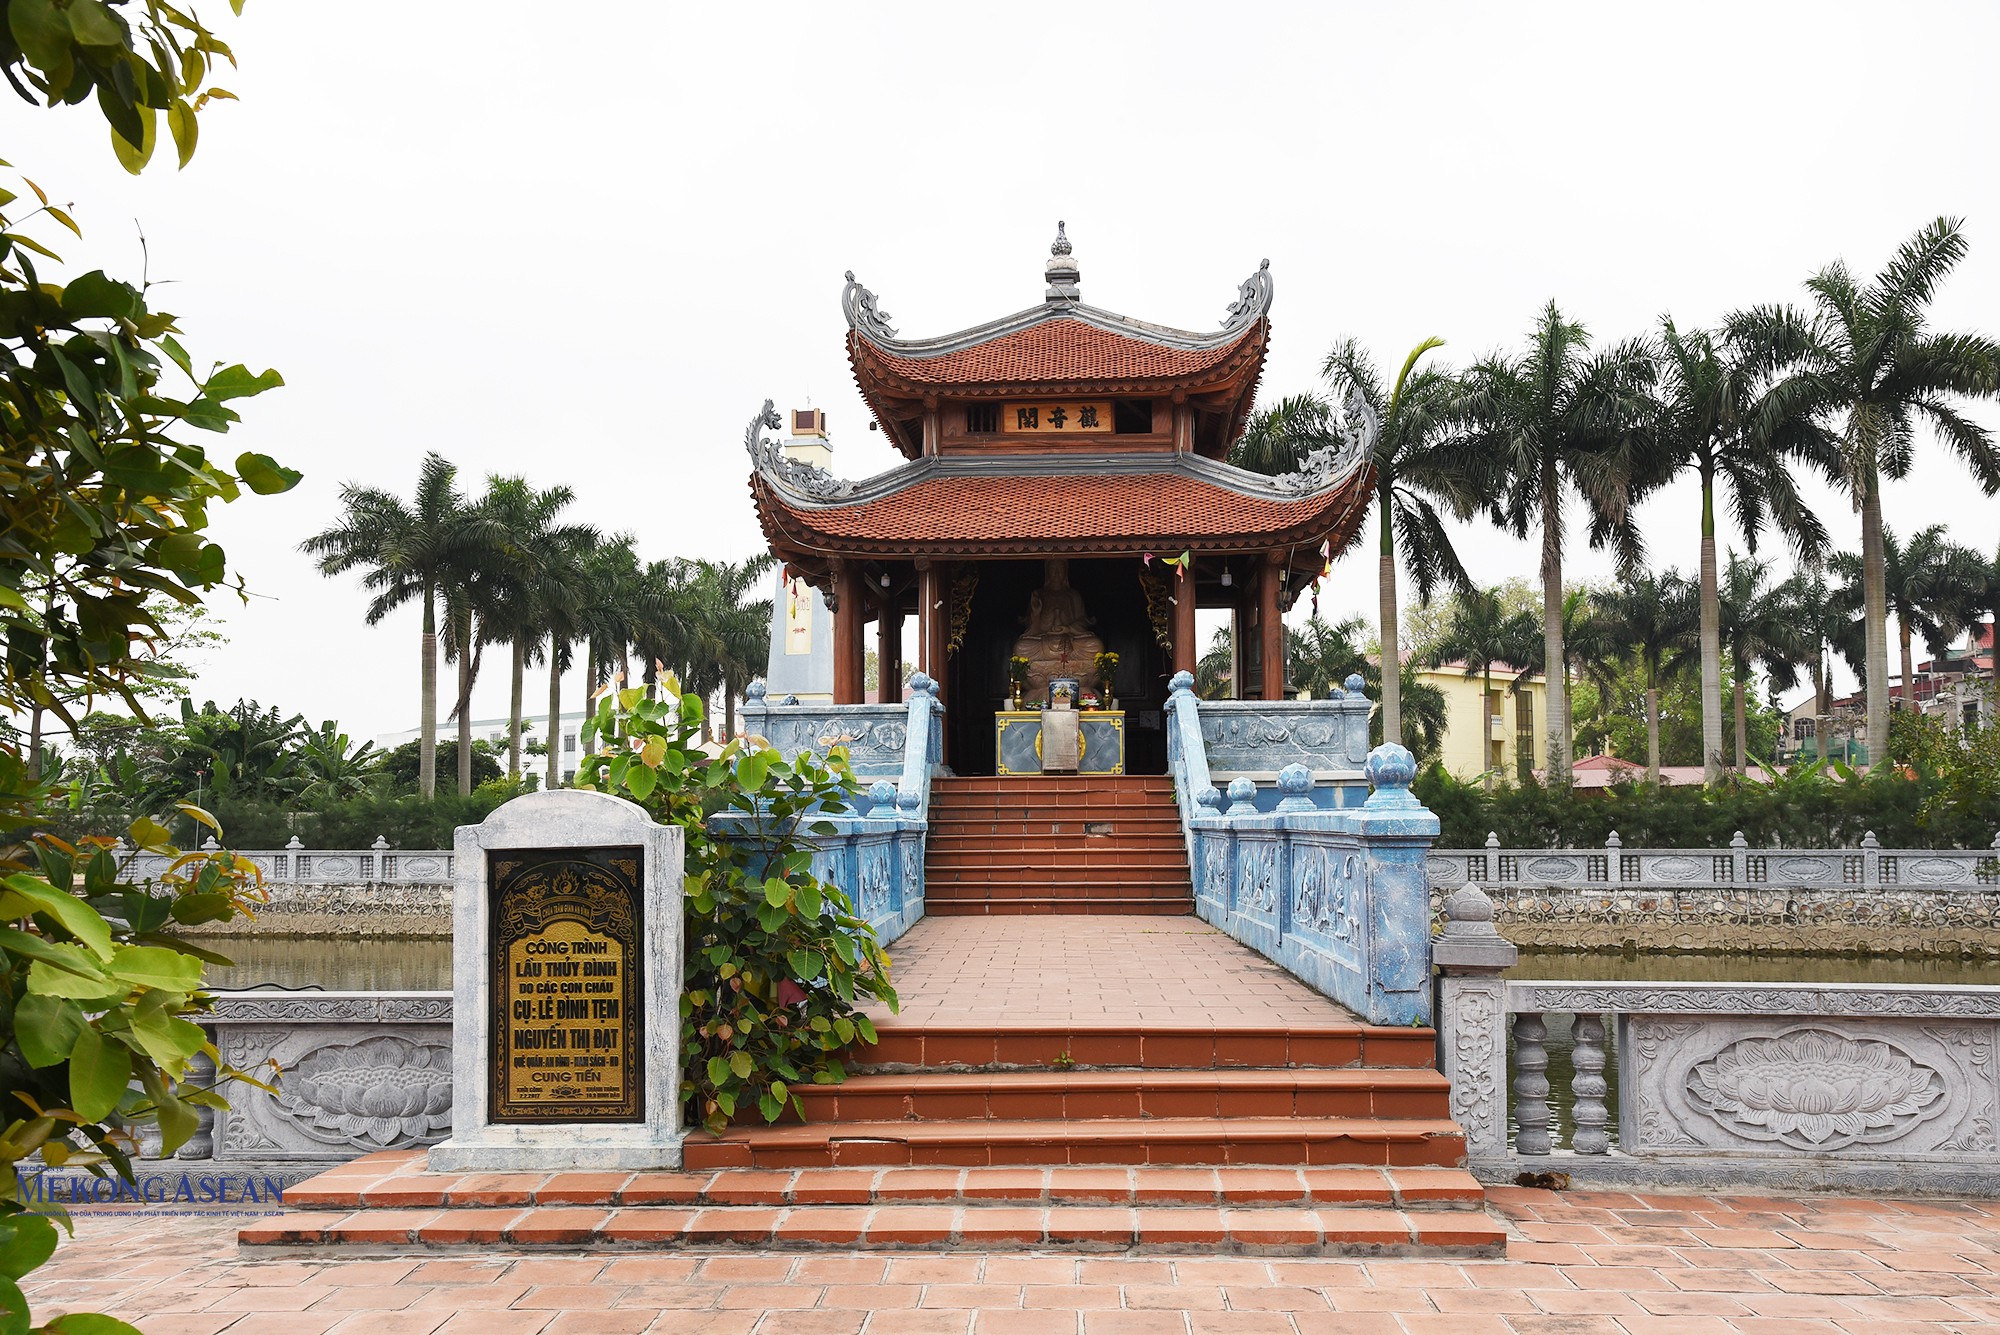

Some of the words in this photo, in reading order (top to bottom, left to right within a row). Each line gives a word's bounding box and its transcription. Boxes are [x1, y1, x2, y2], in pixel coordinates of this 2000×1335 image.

[525, 938, 568, 955] CÔNG
[571, 937, 608, 955] TRÌNH
[516, 957, 542, 977] LẦU
[545, 956, 580, 977] THỦY
[583, 957, 617, 977] ĐÌNH
[519, 983, 534, 994] DO
[536, 980, 558, 994] CÁC
[560, 982, 582, 994] CON
[585, 980, 613, 994] CHÁU
[513, 999, 536, 1024] CỤ:
[538, 995, 554, 1019] LÊ
[556, 996, 589, 1019] ĐÌNH
[592, 999, 619, 1023] TẸM
[514, 1023, 567, 1050] NGUYỄN
[570, 1029, 590, 1053] THỊ
[593, 1029, 619, 1053] ĐẠT
[531, 1071, 572, 1082] CUNG
[575, 1068, 601, 1082] TIẾN
